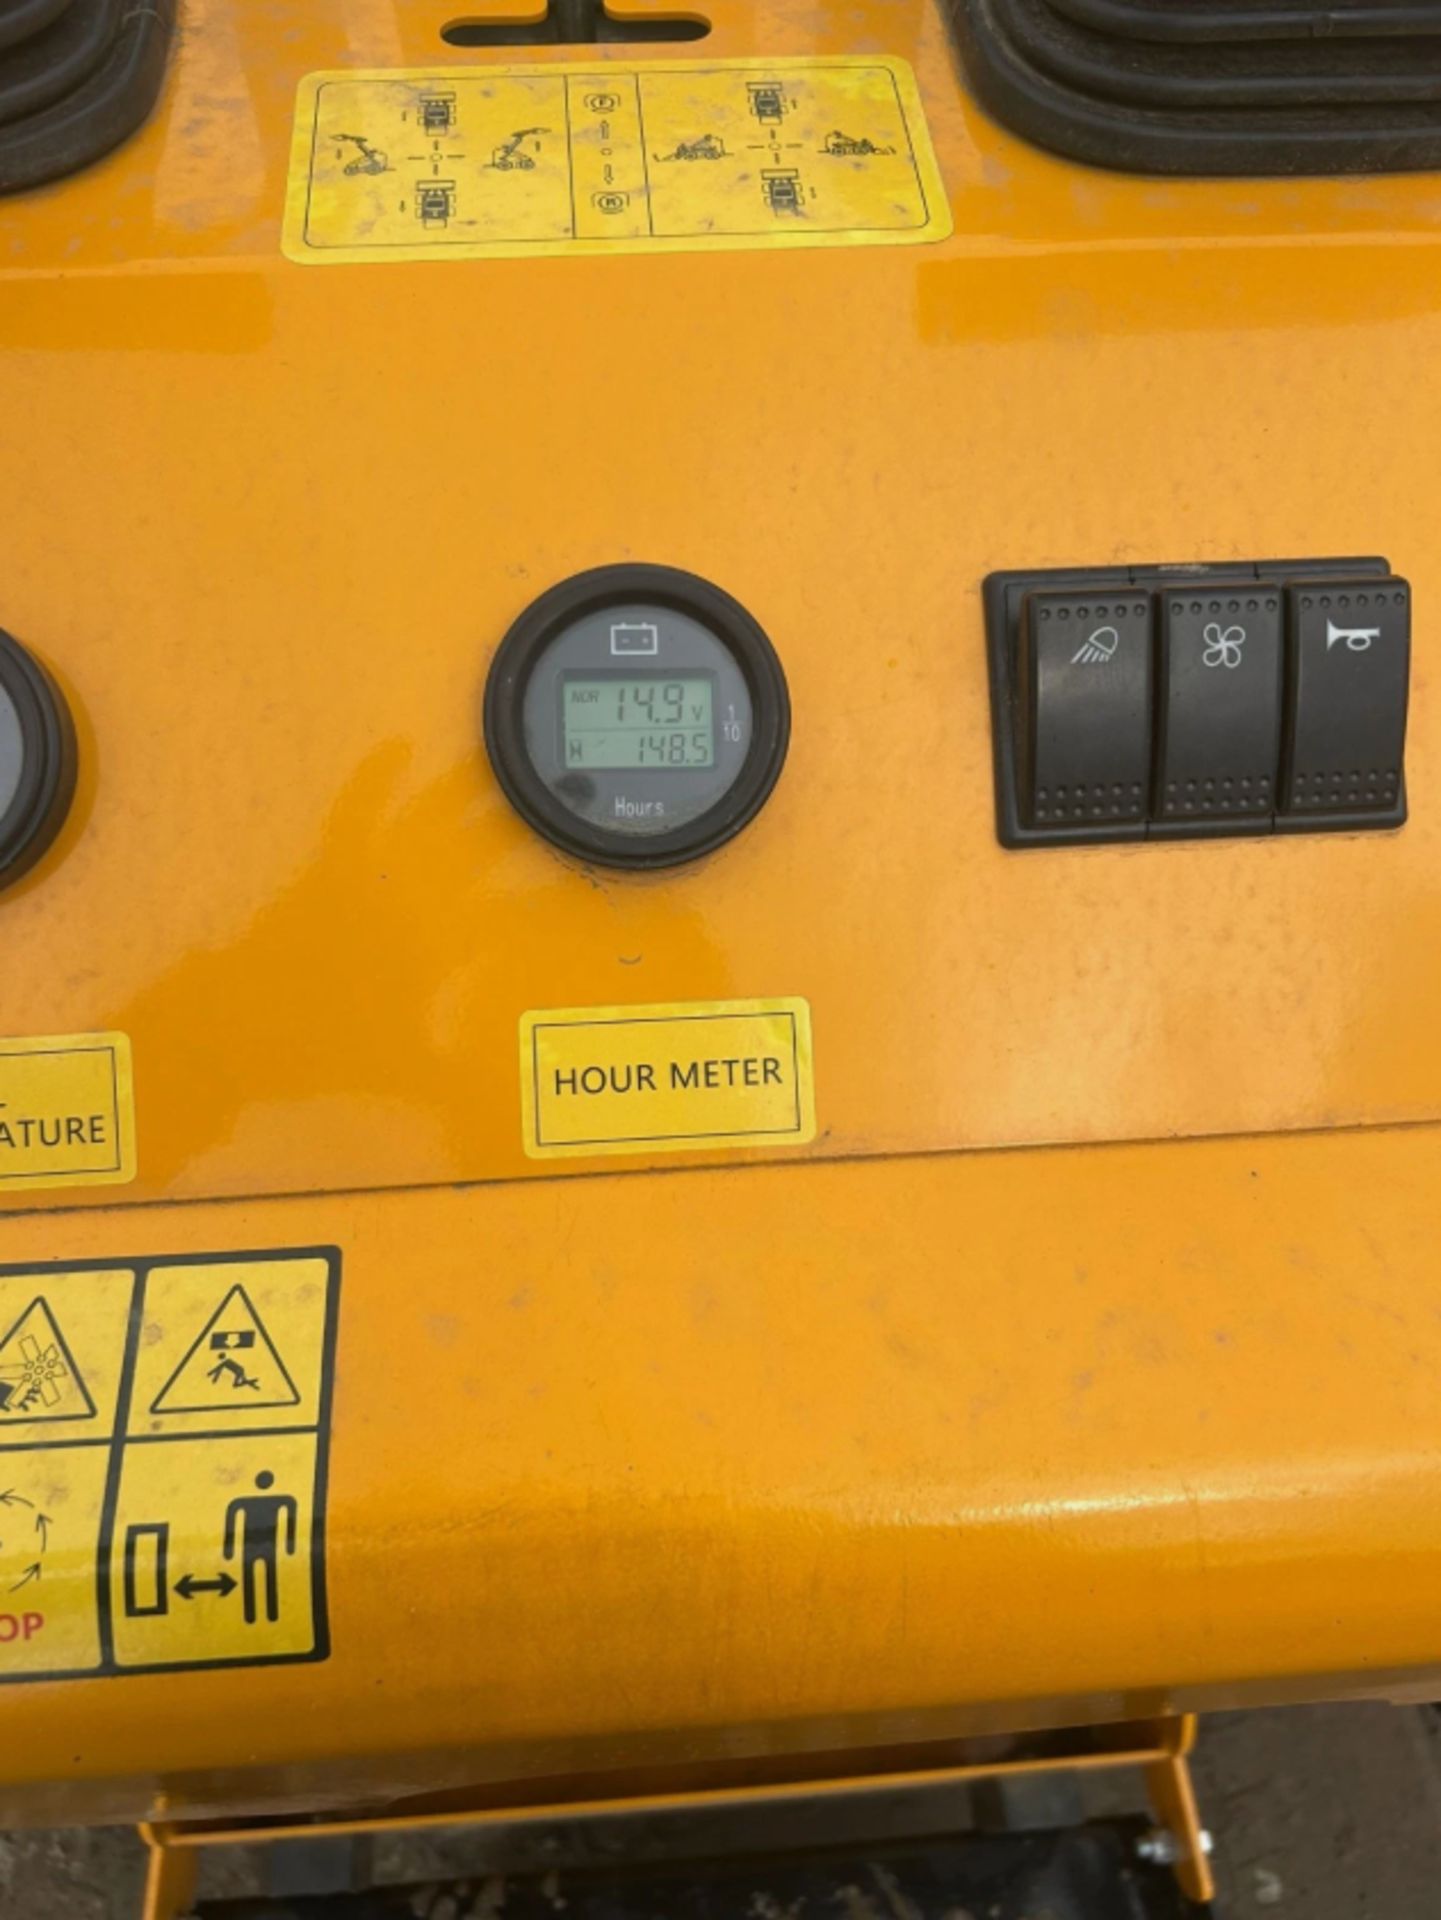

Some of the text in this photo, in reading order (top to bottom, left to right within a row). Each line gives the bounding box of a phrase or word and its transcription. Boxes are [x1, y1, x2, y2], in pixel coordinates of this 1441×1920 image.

[572, 689, 600, 703] NOR
[617, 683, 684, 724] 14.9
[638, 733, 708, 764] 148.5
[615, 796, 665, 817] Hours
[555, 1057, 783, 1095] HOUR METER
